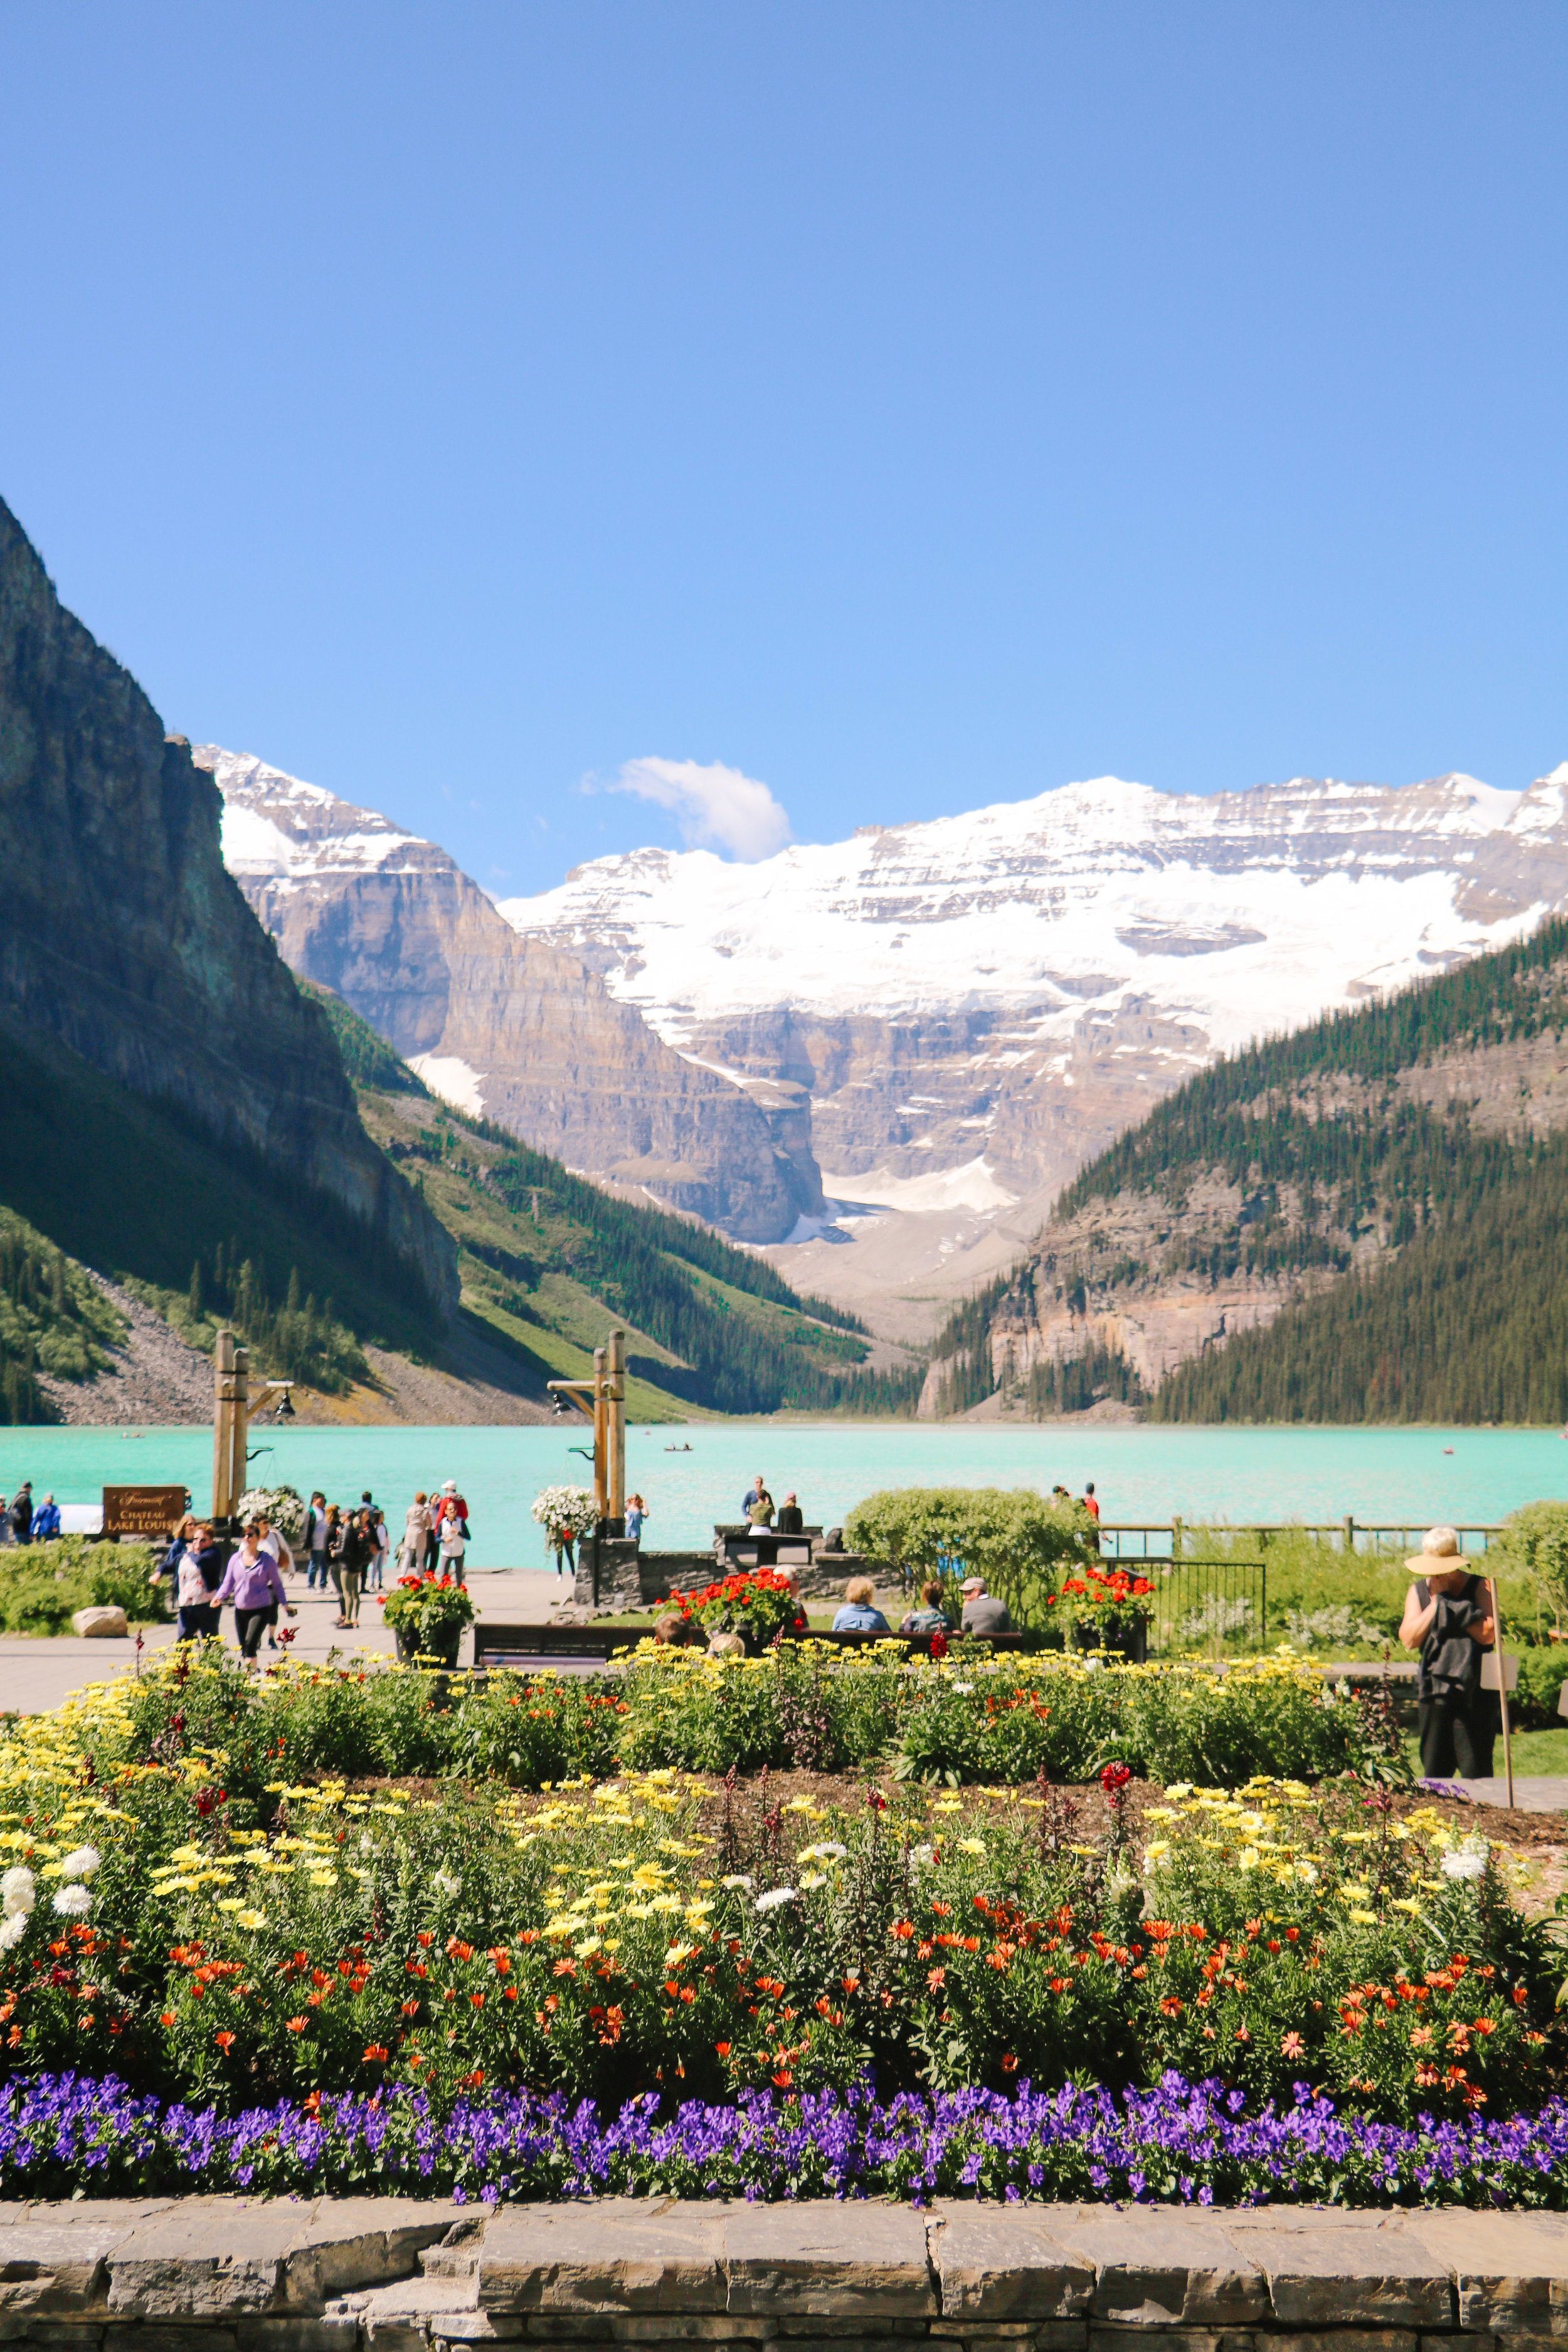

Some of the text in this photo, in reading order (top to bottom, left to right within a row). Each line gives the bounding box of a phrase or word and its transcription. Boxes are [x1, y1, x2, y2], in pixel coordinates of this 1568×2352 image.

[119, 1492, 166, 1506] Fairmont
[120, 1510, 166, 1519] CHATEAU
[108, 1519, 134, 1530] LAKE
